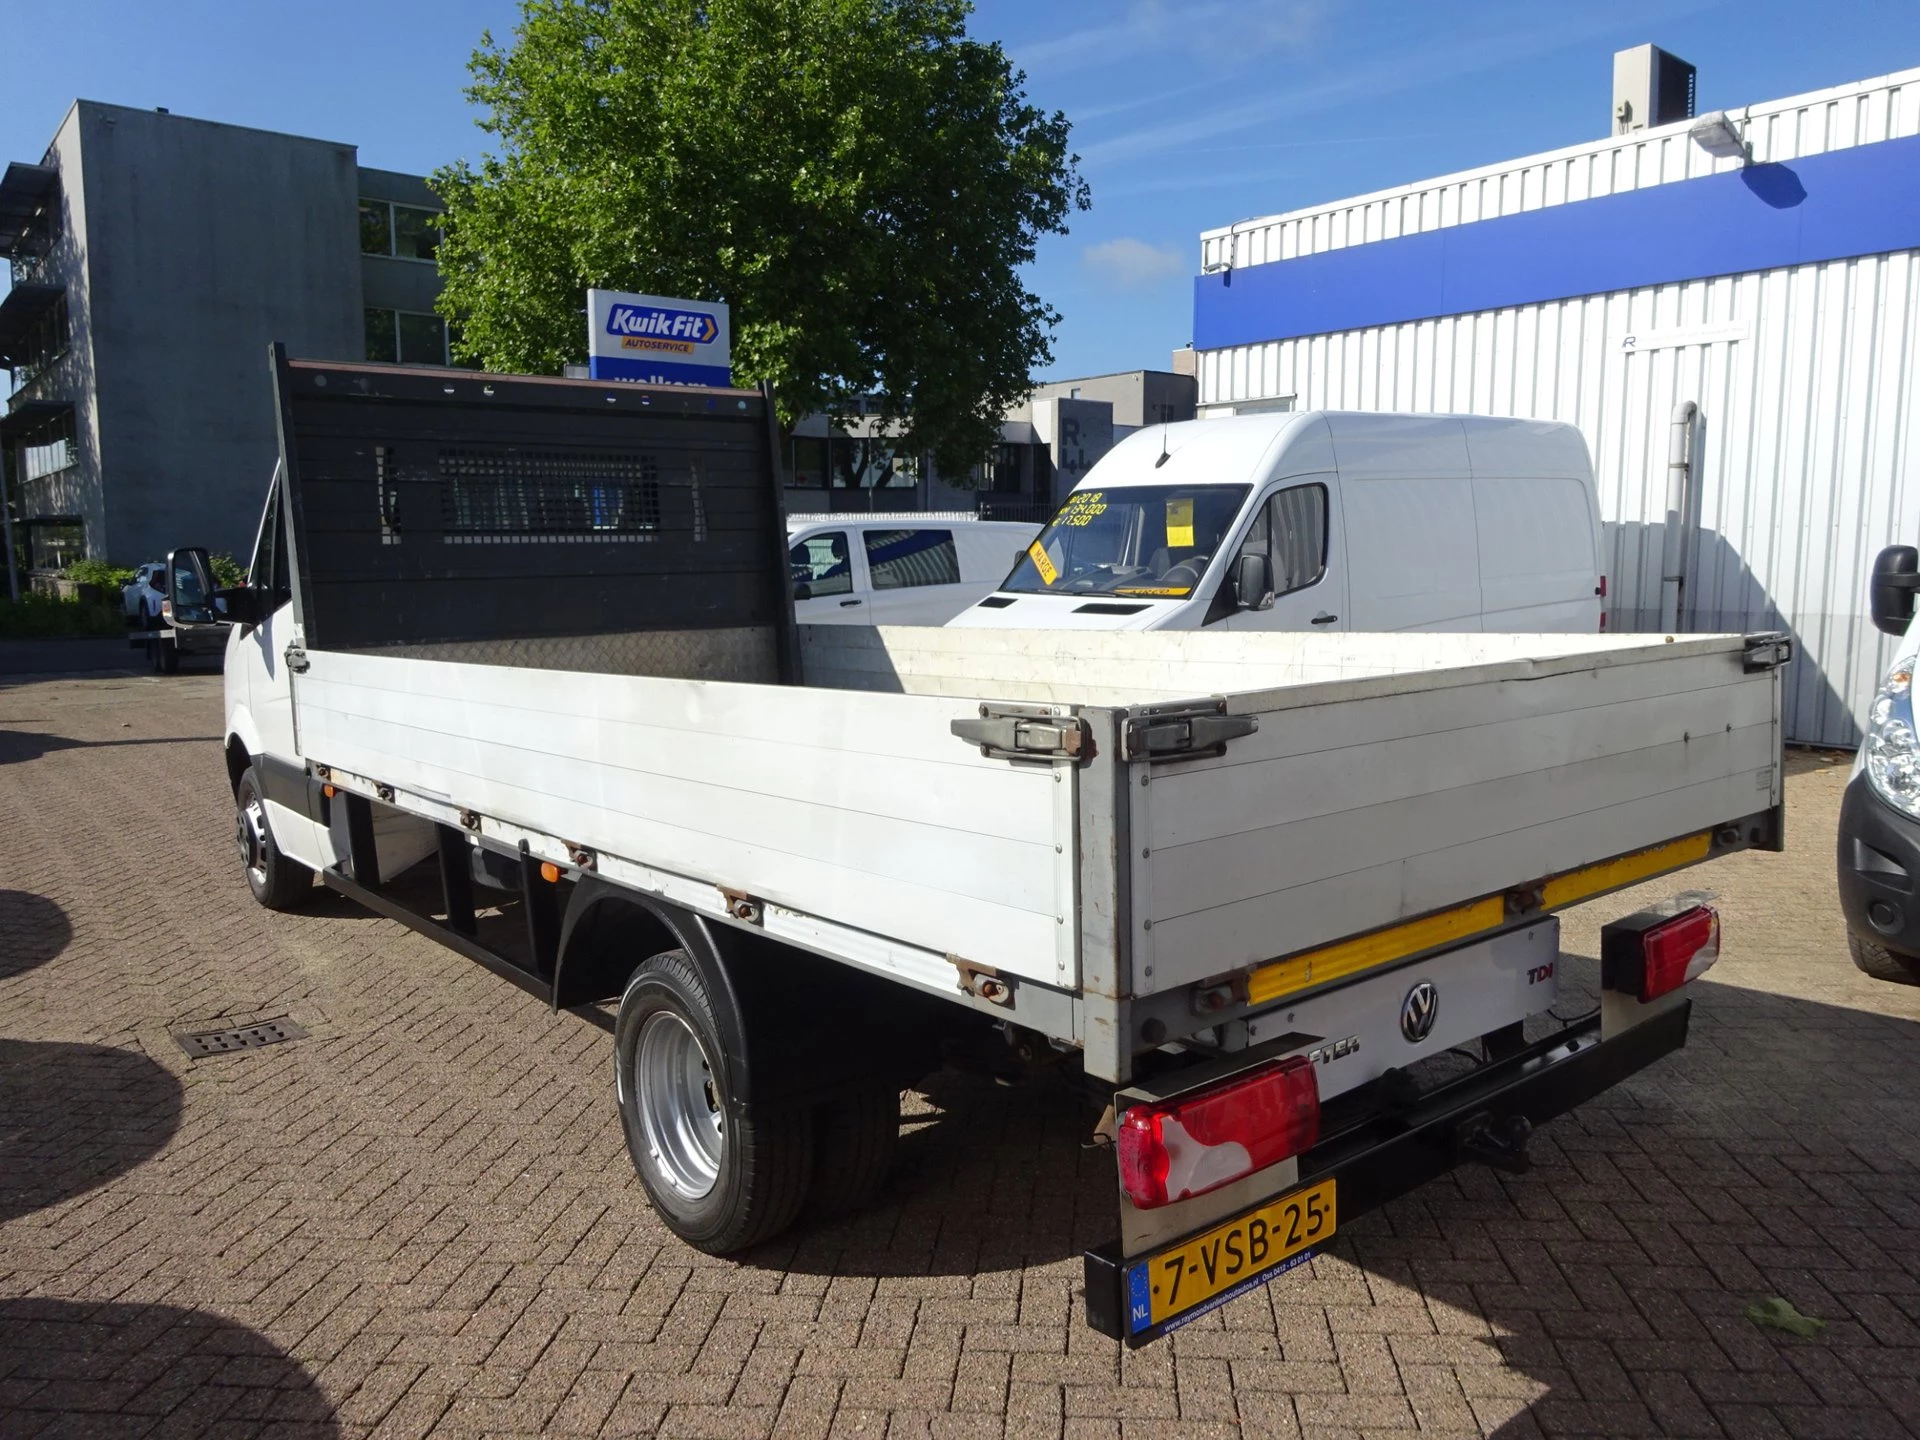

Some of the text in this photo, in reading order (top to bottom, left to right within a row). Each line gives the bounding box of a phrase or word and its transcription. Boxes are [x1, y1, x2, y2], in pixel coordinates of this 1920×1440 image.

[625, 338, 690, 353] AUTOSERVICE
[1033, 548, 1053, 577] MARGE
[1526, 961, 1554, 986] TDI
[1308, 1034, 1360, 1064] FTER
[1164, 1192, 1324, 1306] 7-VSB-25
[1273, 1264, 1287, 1277] 0412
[1132, 1303, 1149, 1322] NL
